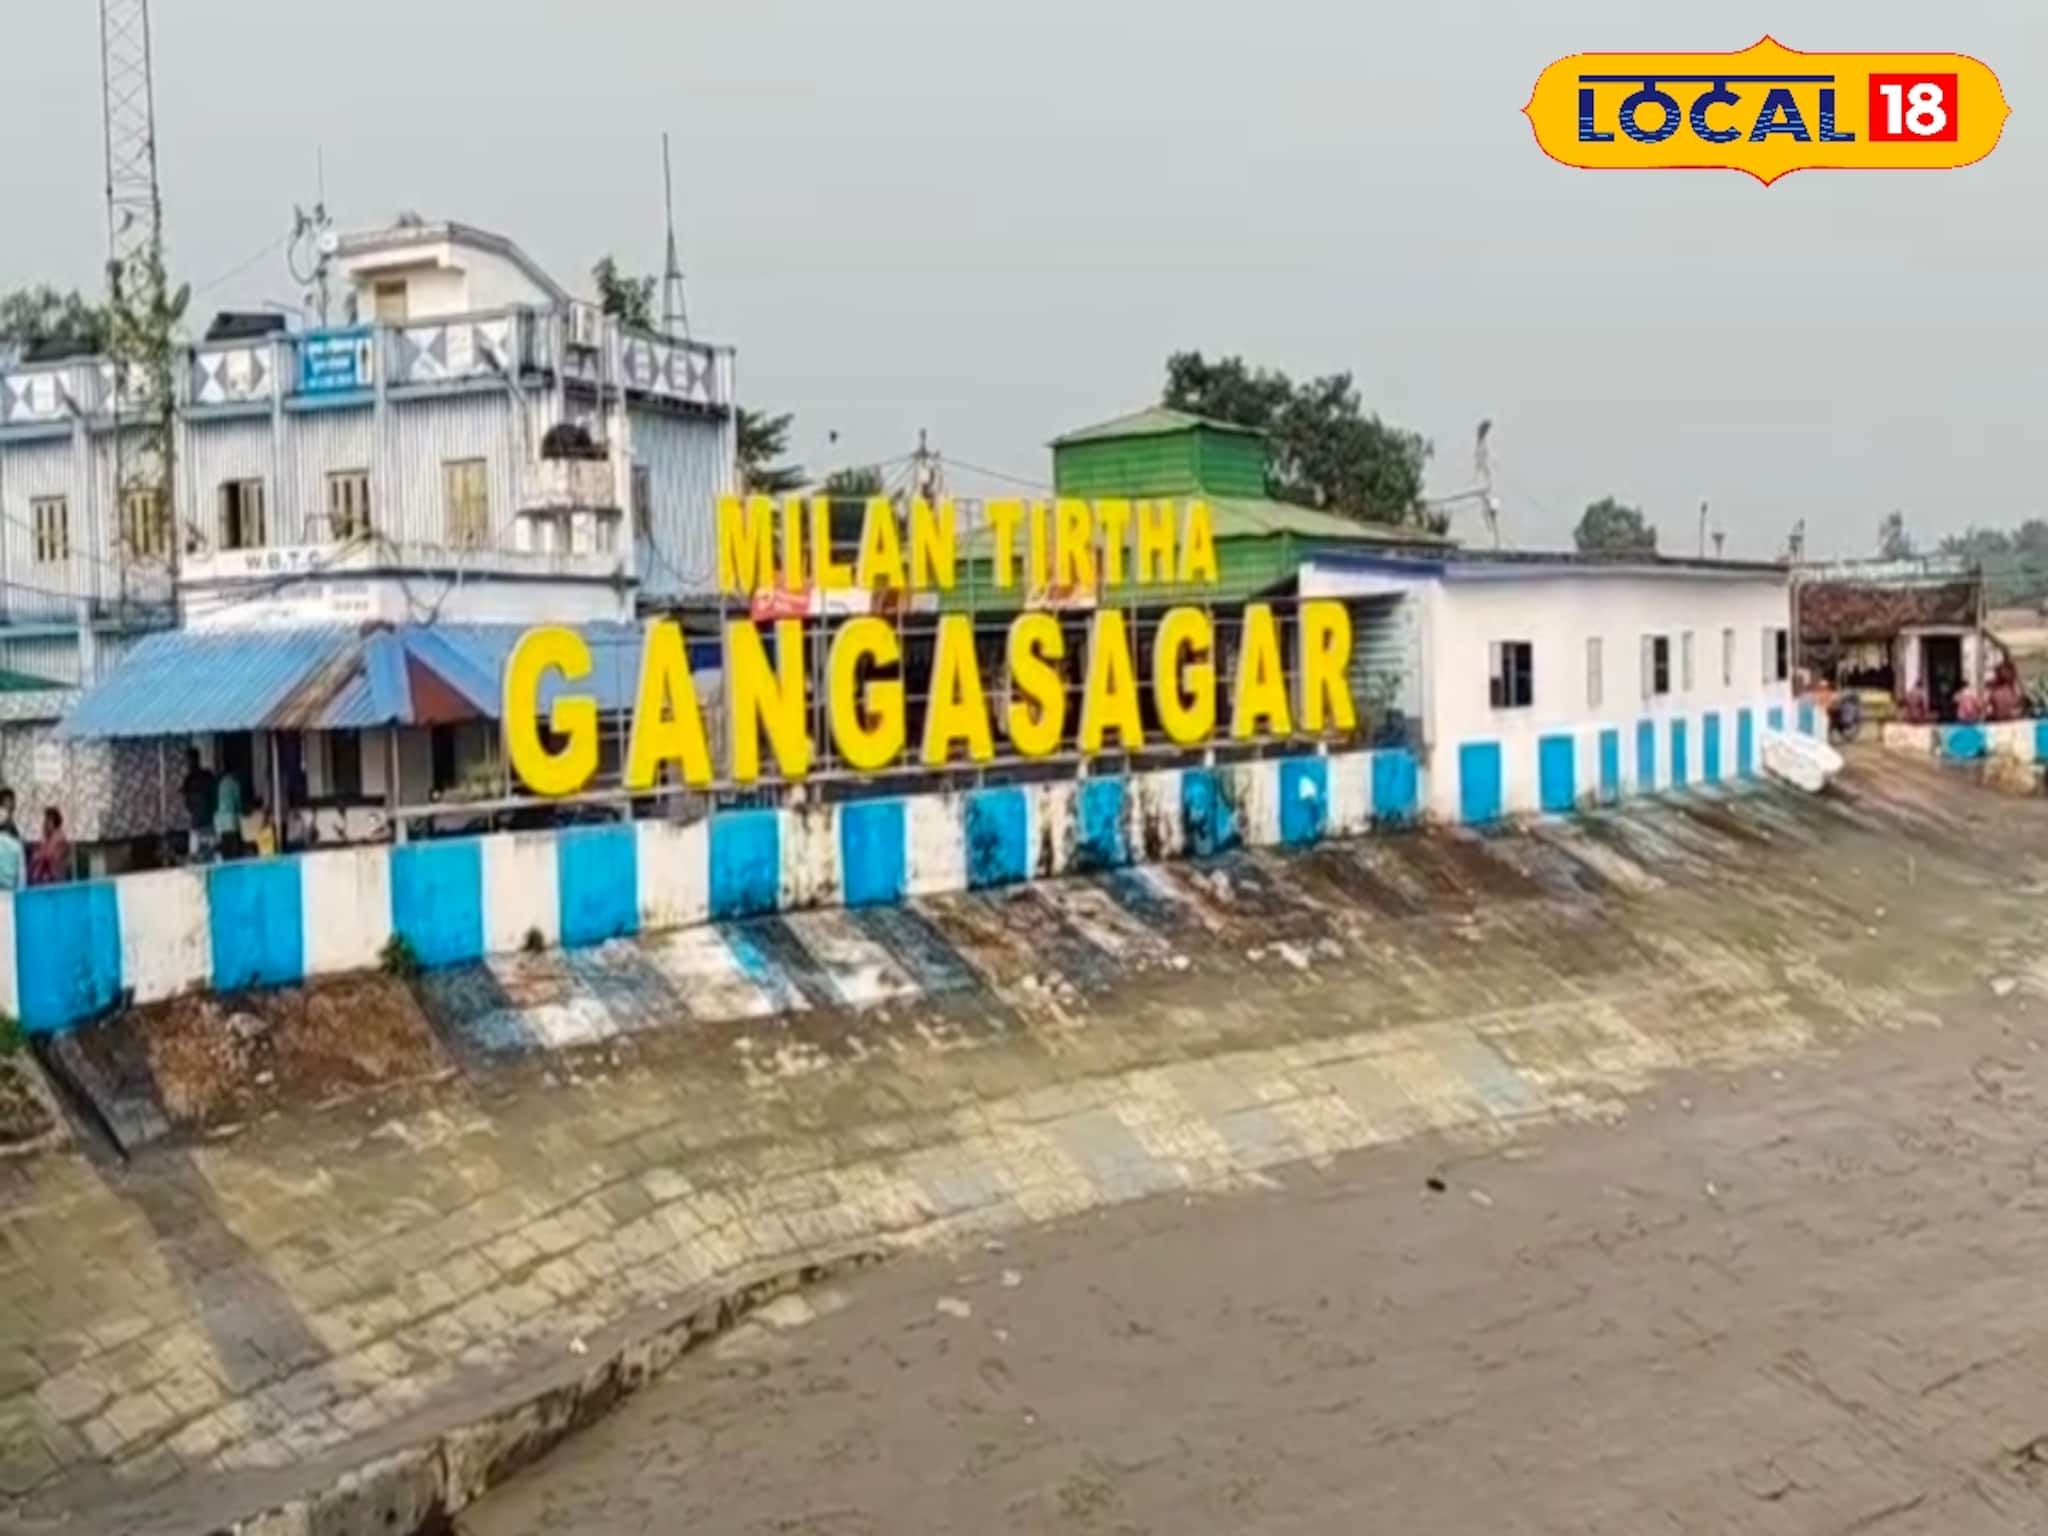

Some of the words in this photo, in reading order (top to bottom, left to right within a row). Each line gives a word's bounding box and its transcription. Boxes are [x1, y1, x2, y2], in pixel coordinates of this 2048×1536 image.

[717, 493, 960, 595] MILAN
[985, 495, 1219, 592] TIRTHA
[503, 600, 1357, 798] GANGASAGAR
